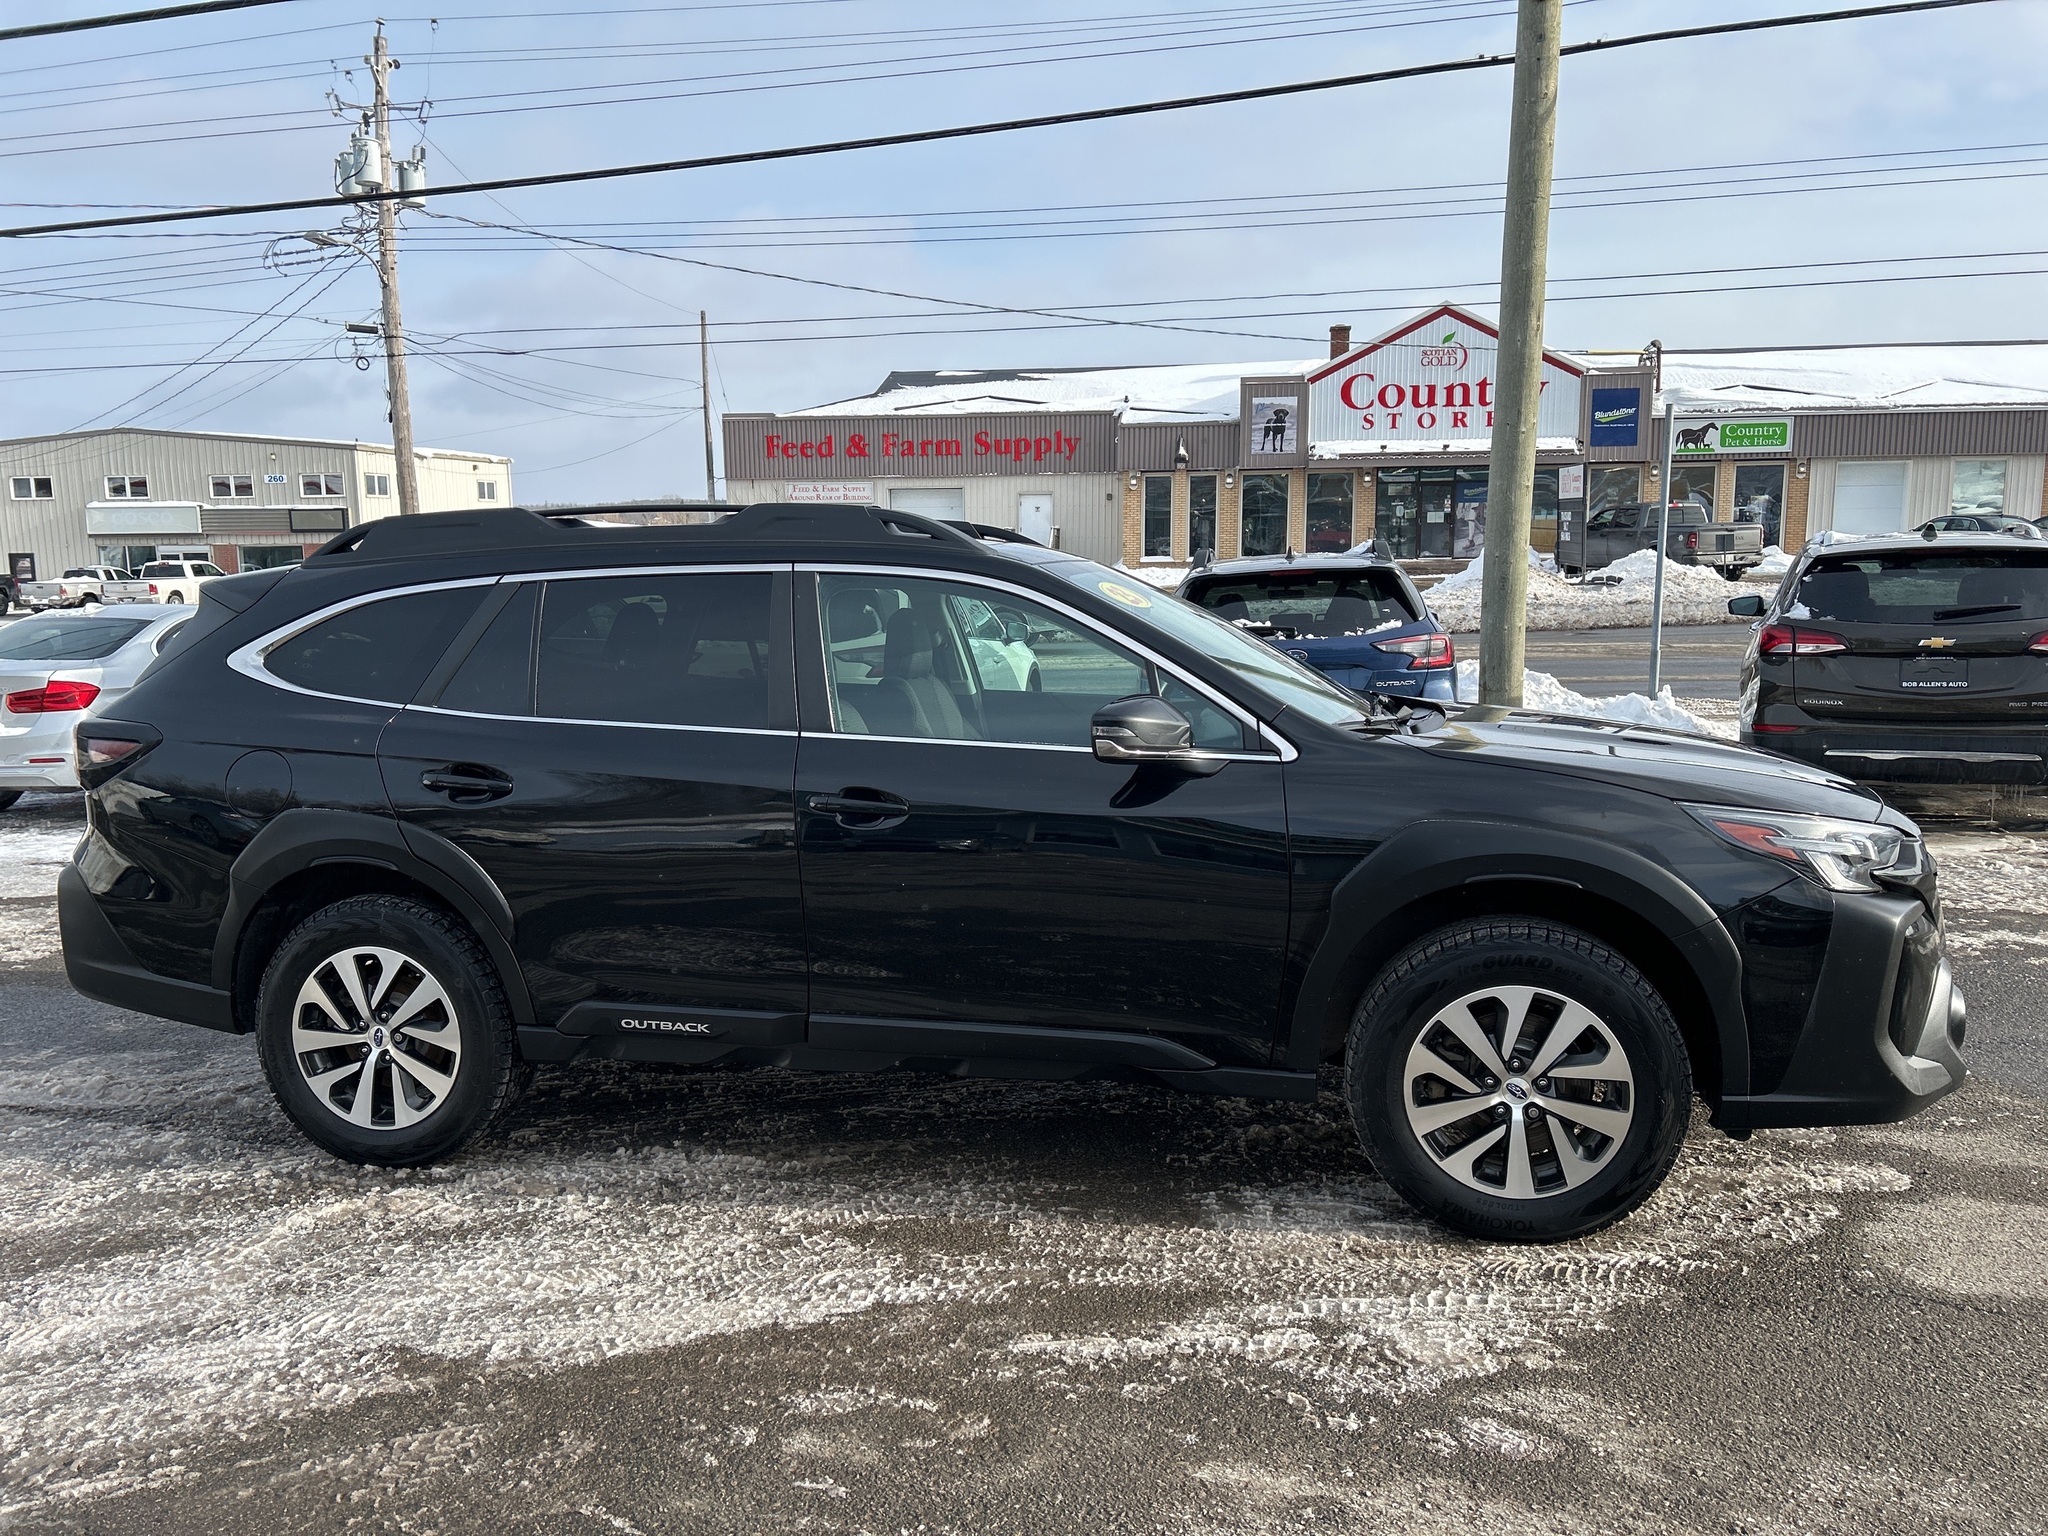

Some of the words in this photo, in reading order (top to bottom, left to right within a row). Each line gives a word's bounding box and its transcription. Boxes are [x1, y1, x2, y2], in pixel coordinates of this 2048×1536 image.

[1421, 356, 1457, 367] GOLD
[1340, 373, 1549, 410] Count
[1594, 407, 1637, 419] Blundstone
[1726, 424, 1783, 438] Country
[764, 434, 836, 458] Feed
[845, 433, 871, 458] &
[881, 432, 963, 457] Farm
[973, 429, 1082, 462] Supply
[1725, 437, 1740, 446] Pet
[1754, 436, 1782, 446] Horse
[267, 475, 284, 483] 260
[812, 484, 820, 492] &
[620, 1018, 711, 1034] OUTBACK
[1442, 1196, 1537, 1233] YOKOHAMA
